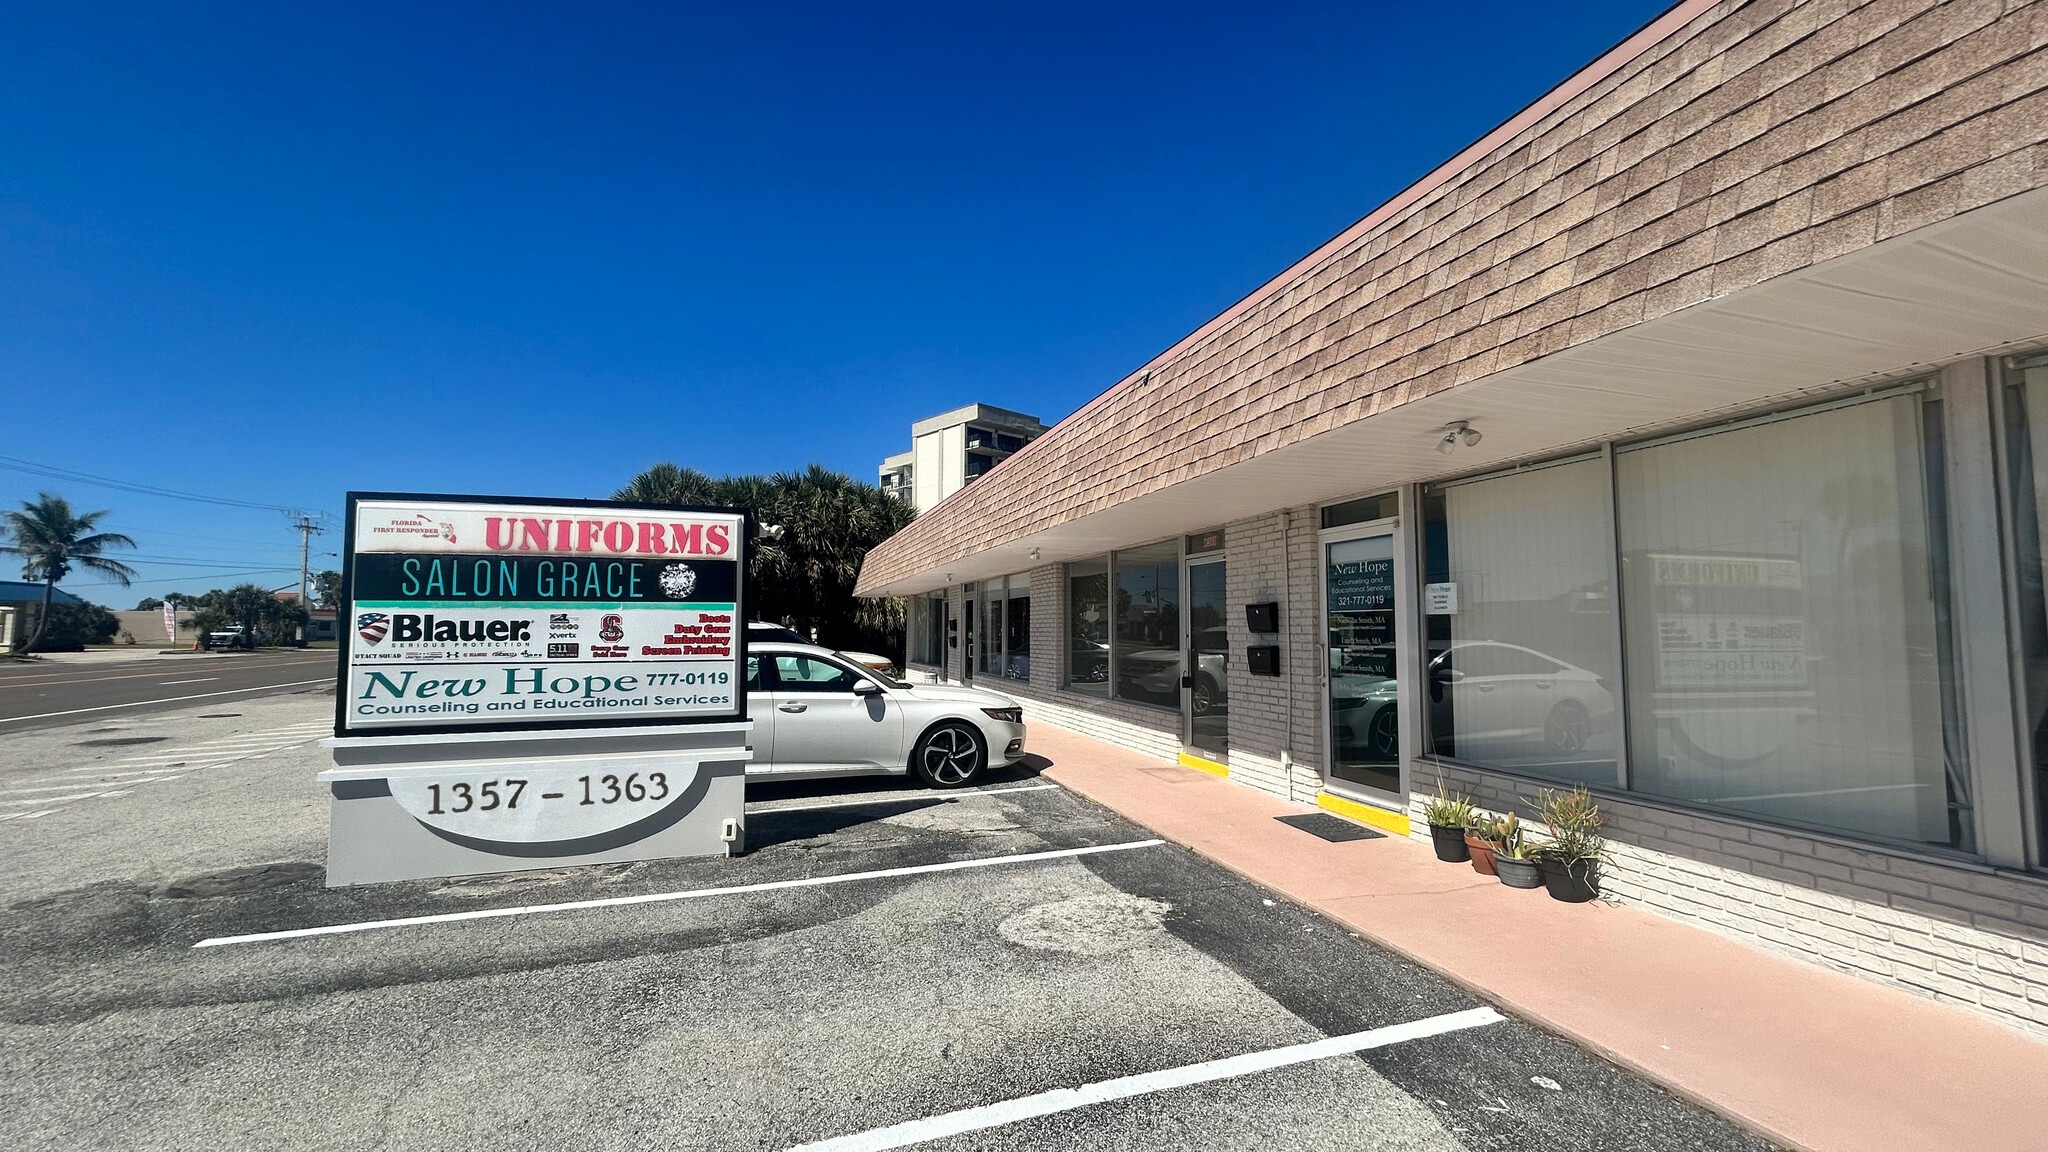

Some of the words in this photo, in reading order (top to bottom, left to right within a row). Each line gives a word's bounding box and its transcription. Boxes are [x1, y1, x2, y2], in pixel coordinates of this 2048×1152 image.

[484, 517, 730, 556] UNIFORMS
[1334, 564, 1357, 575] New
[1359, 561, 1389, 575] Hope
[402, 558, 518, 597] SALON
[537, 562, 644, 597] GRACE
[1337, 577, 1370, 586] Counseling
[1331, 586, 1366, 595] Educational
[1338, 595, 1385, 606] 321-777-0119
[699, 613, 731, 623] Boots
[674, 624, 702, 635] Duty
[704, 624, 731, 633] Gear
[664, 635, 731, 646] Embroidery
[642, 645, 682, 655] Screen
[683, 645, 730, 656] Printing
[359, 670, 487, 700] New
[500, 667, 638, 700] Hope
[646, 672, 729, 687] 777-0119
[357, 700, 479, 715] Counseling
[486, 699, 527, 711] and
[533, 695, 648, 710] Educational
[654, 693, 730, 706] Services
[427, 779, 528, 815] 1357
[578, 772, 669, 806] 1363
